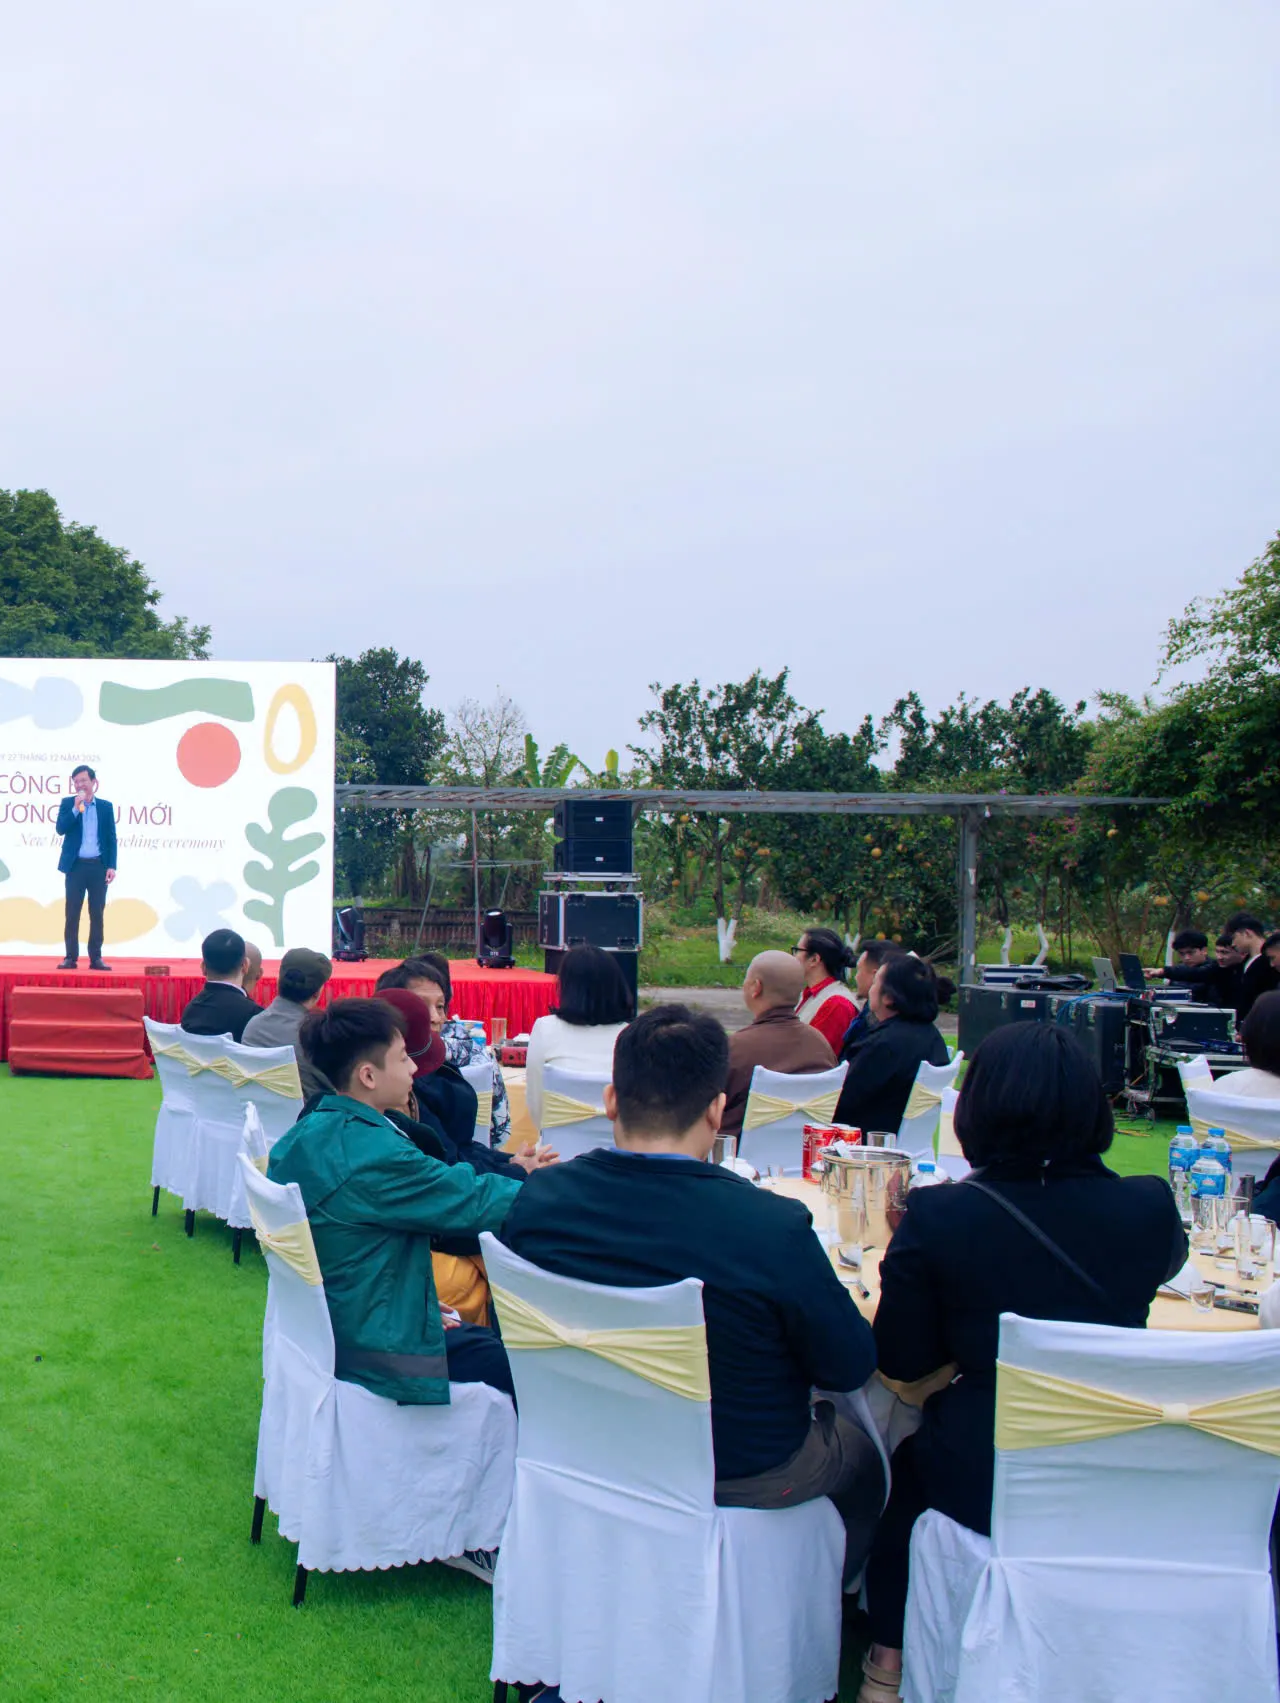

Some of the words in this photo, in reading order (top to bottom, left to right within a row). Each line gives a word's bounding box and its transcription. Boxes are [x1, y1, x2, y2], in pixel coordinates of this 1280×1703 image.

[128, 802, 172, 826] MỚI
[117, 833, 160, 851] nching
[161, 838, 226, 853] ceremony
